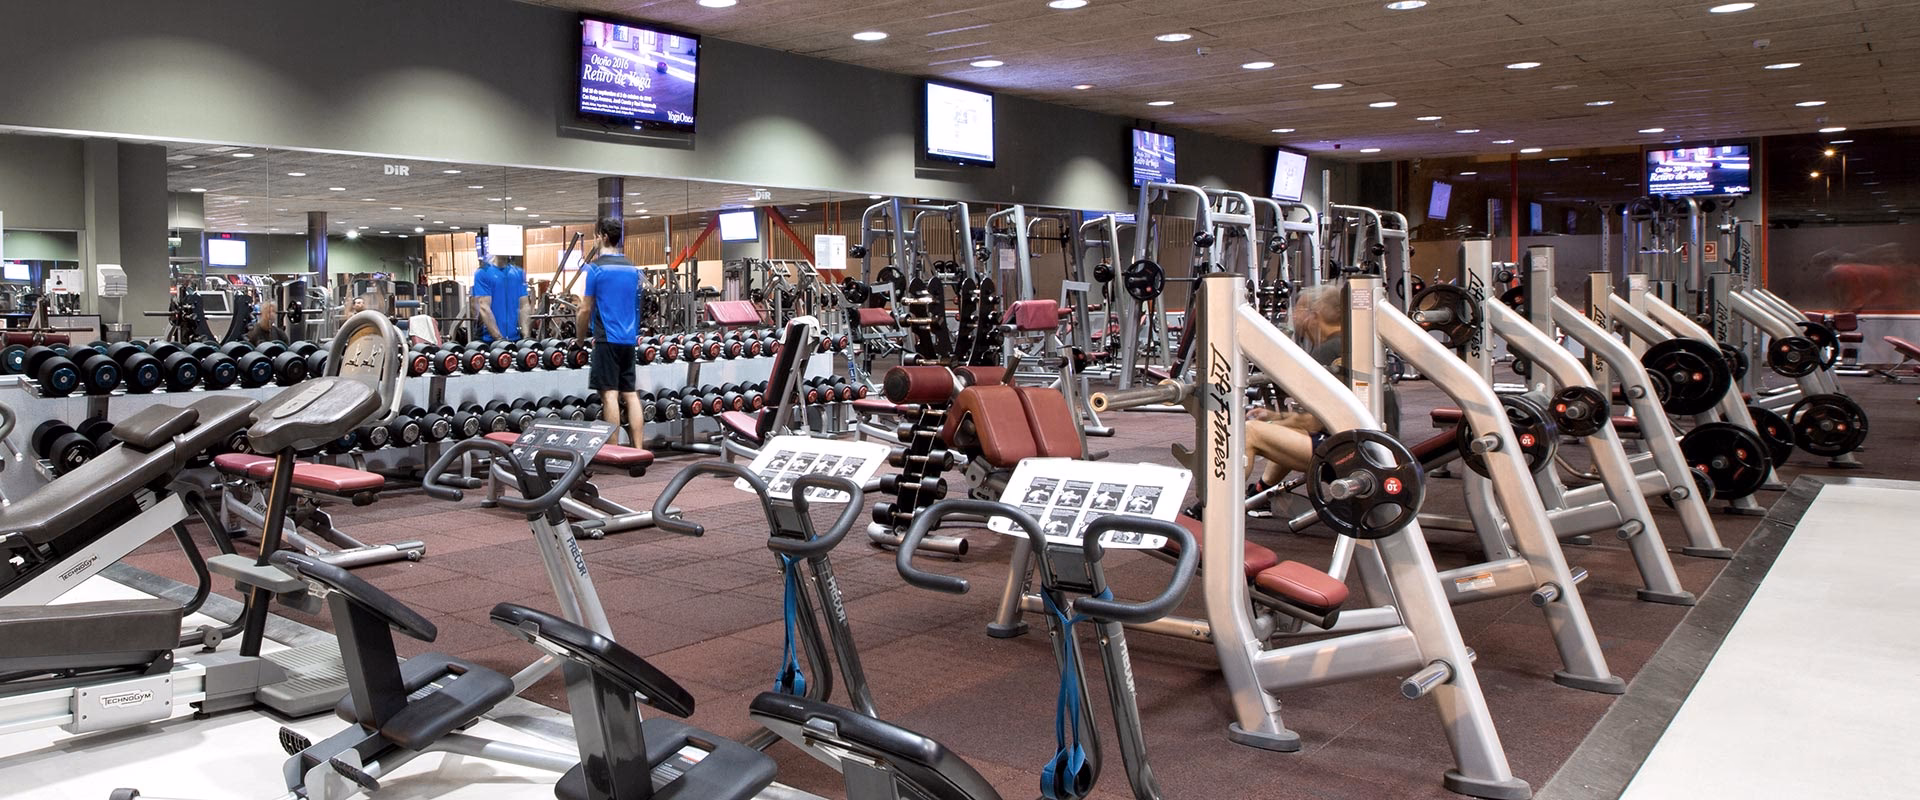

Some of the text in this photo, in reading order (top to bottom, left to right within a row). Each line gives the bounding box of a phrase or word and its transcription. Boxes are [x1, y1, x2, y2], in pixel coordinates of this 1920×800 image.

[591, 54, 629, 69] Otoño 2016
[583, 64, 651, 91] Retiro de Yoga
[384, 164, 410, 176] DiR
[1210, 342, 1232, 481] Life Fitness
[1386, 483, 1398, 492] 10
[566, 536, 587, 577] PRECOR
[827, 575, 847, 624] PRECOR
